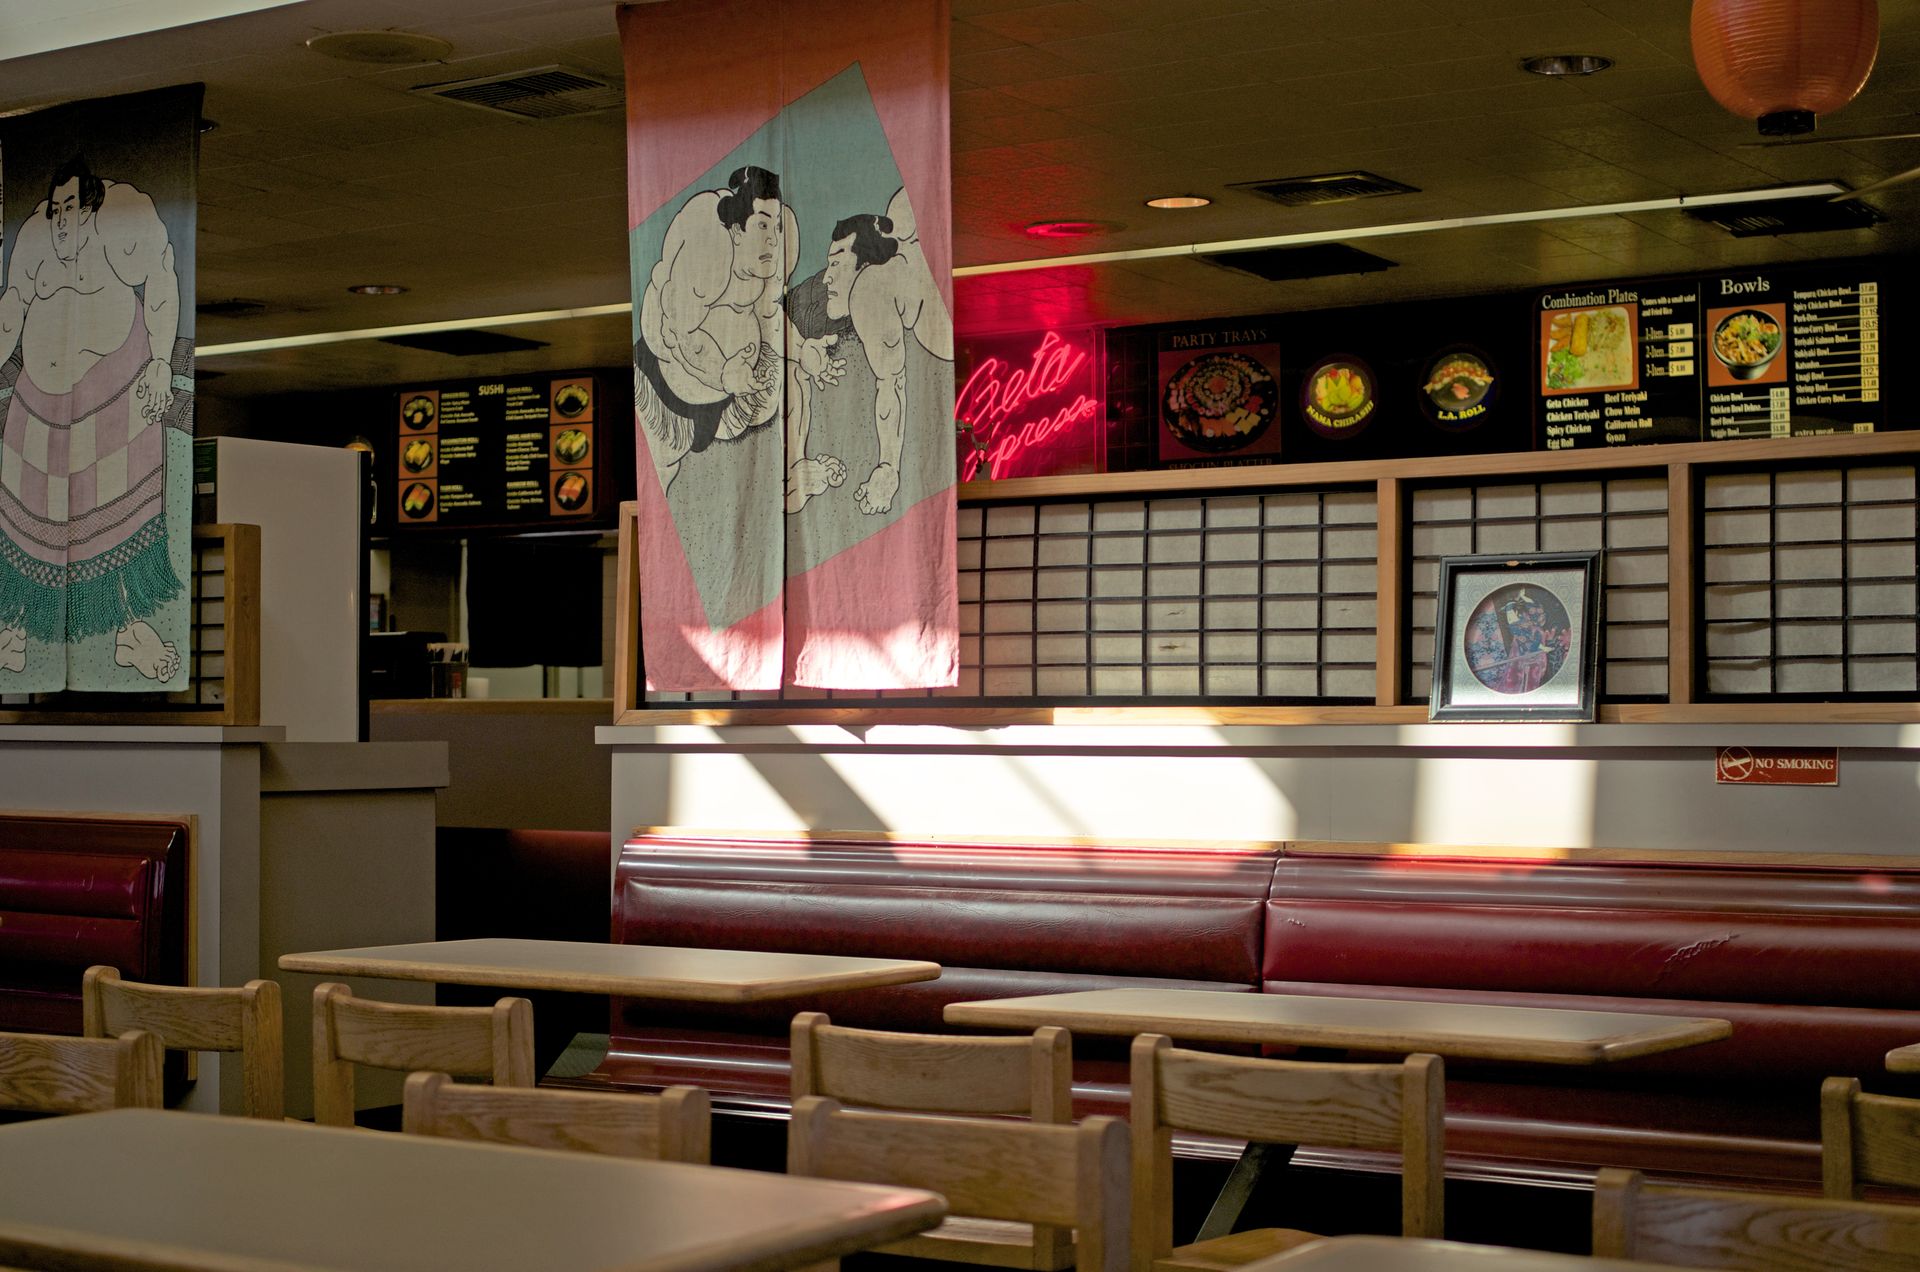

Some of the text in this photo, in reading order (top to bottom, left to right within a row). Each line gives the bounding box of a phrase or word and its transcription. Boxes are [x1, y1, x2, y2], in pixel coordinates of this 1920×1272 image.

[1720, 276, 1771, 295] Bowls
[1541, 288, 1639, 309] Combination Plates
[1171, 328, 1267, 348] PARTY TRAYS
[478, 383, 505, 396] SUSHI
[1546, 397, 1589, 409] Geta Chicken
[1604, 391, 1648, 403] Beef Teriyaki
[1306, 404, 1332, 427] NAMA
[1437, 403, 1486, 420] L.A. ROLL
[1546, 409, 1600, 422] Chicken Teriyaki
[1604, 405, 1641, 417] Chow Mein
[1546, 423, 1592, 437] Spicy Chicken
[1604, 417, 1653, 430] California Roll
[1546, 437, 1574, 450] Egg Roll
[1605, 433, 1627, 444] Gyoza
[1755, 758, 1834, 770] NO SMOKING
